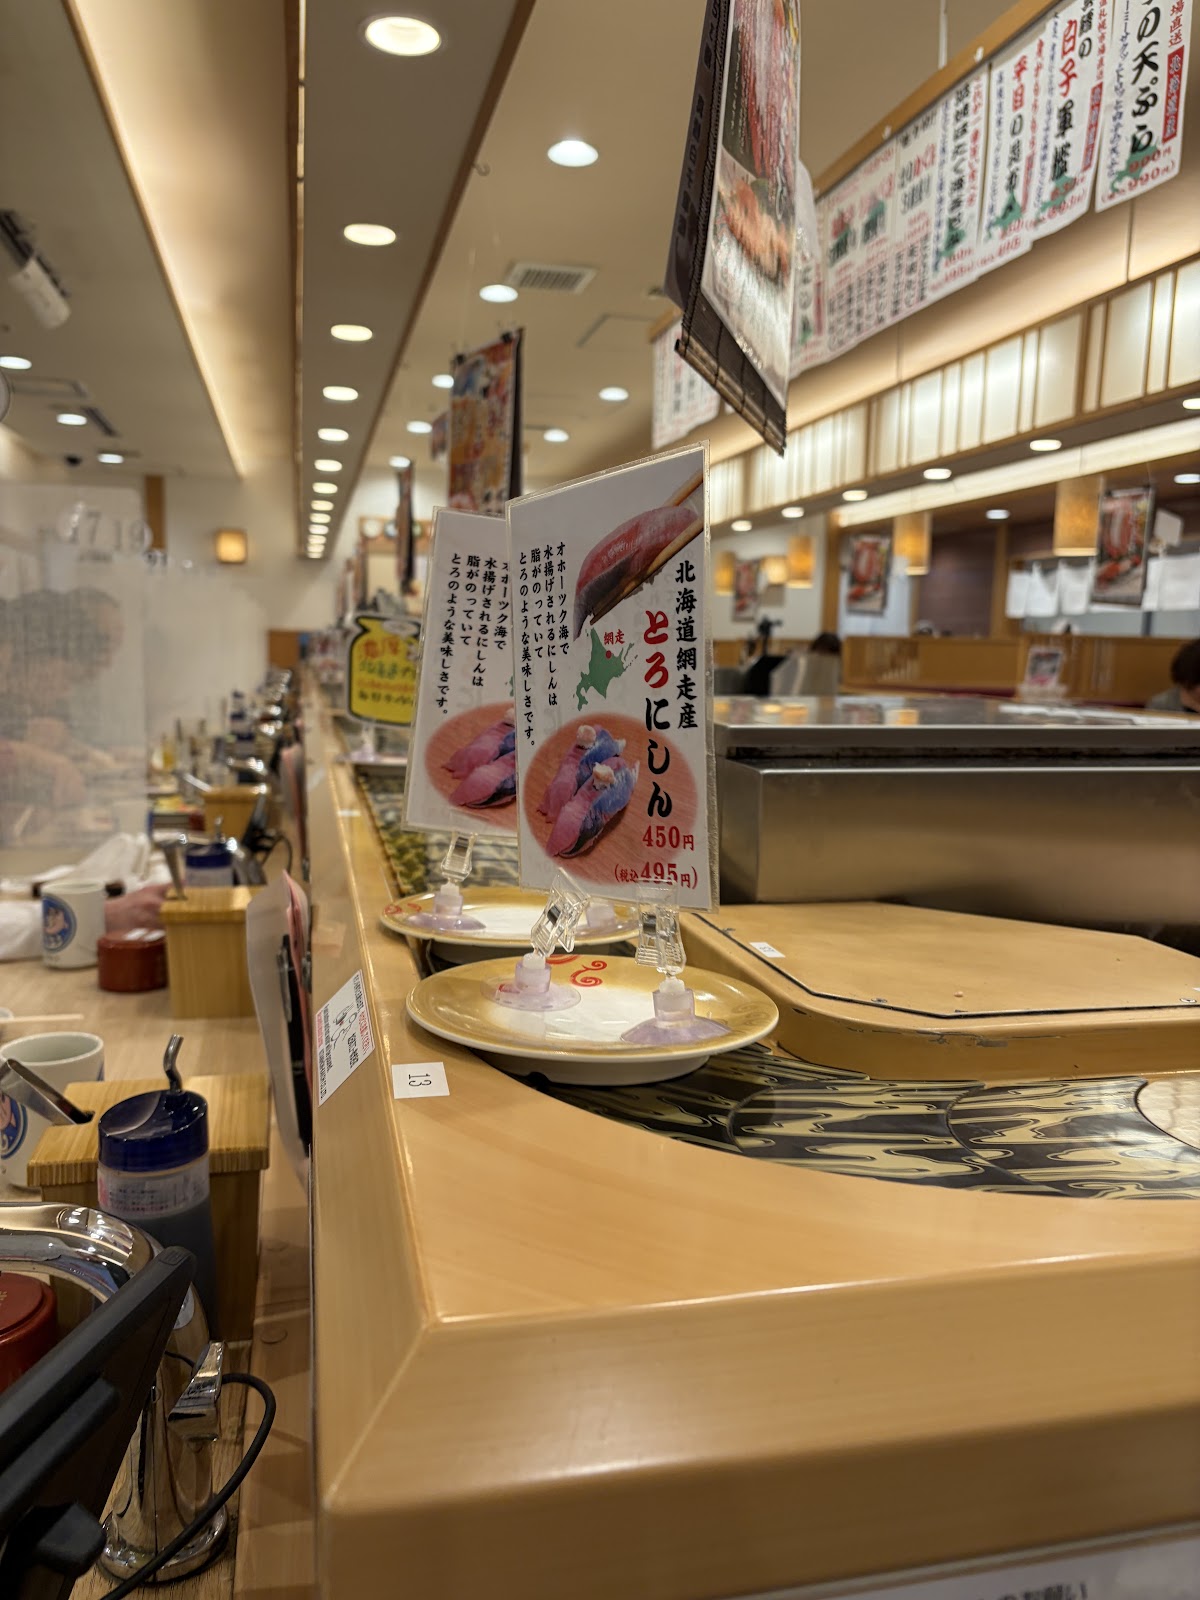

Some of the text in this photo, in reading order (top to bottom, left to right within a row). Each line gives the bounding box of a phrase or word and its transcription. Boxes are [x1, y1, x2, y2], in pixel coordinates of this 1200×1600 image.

[1131, 0, 1161, 154] の天ぷら
[436, 553, 462, 715] とろのような美味しさです。
[460, 555, 480, 646] 脂がのっていて
[472, 557, 498, 688] 水揚げされるにしんは
[519, 551, 535, 746] とろのような美味しさです。
[531, 548, 543, 659] 脂がのっていて
[543, 544, 558, 706] 水揚げされるにしんは
[556, 541, 569, 655] オホーツク海で
[603, 629, 625, 645] 網走
[675, 560, 699, 730] 北海道網走産
[643, 610, 672, 818] とろにしん
[614, 861, 698, 889] (税込495円)
[642, 825, 694, 851] 450円
[408, 1073, 432, 1087] 13
